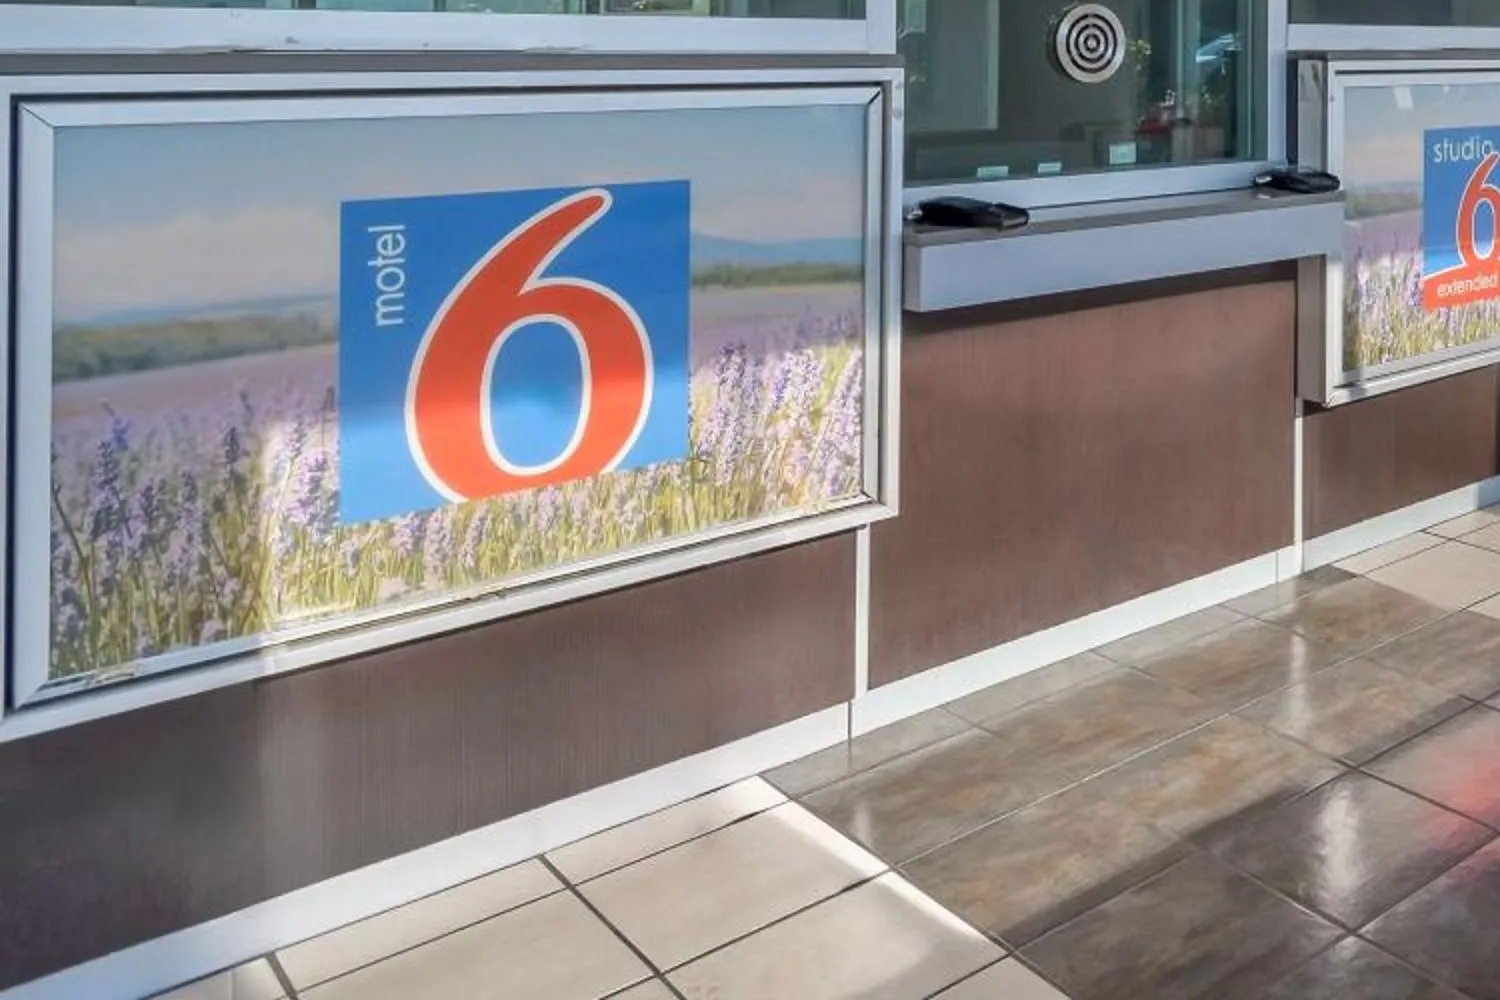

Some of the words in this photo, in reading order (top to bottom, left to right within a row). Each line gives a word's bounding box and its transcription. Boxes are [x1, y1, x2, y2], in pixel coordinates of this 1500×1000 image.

[1433, 135, 1495, 163] studio
[367, 224, 406, 328] motel
[1437, 272, 1499, 298] extended
[404, 187, 654, 504] 6
